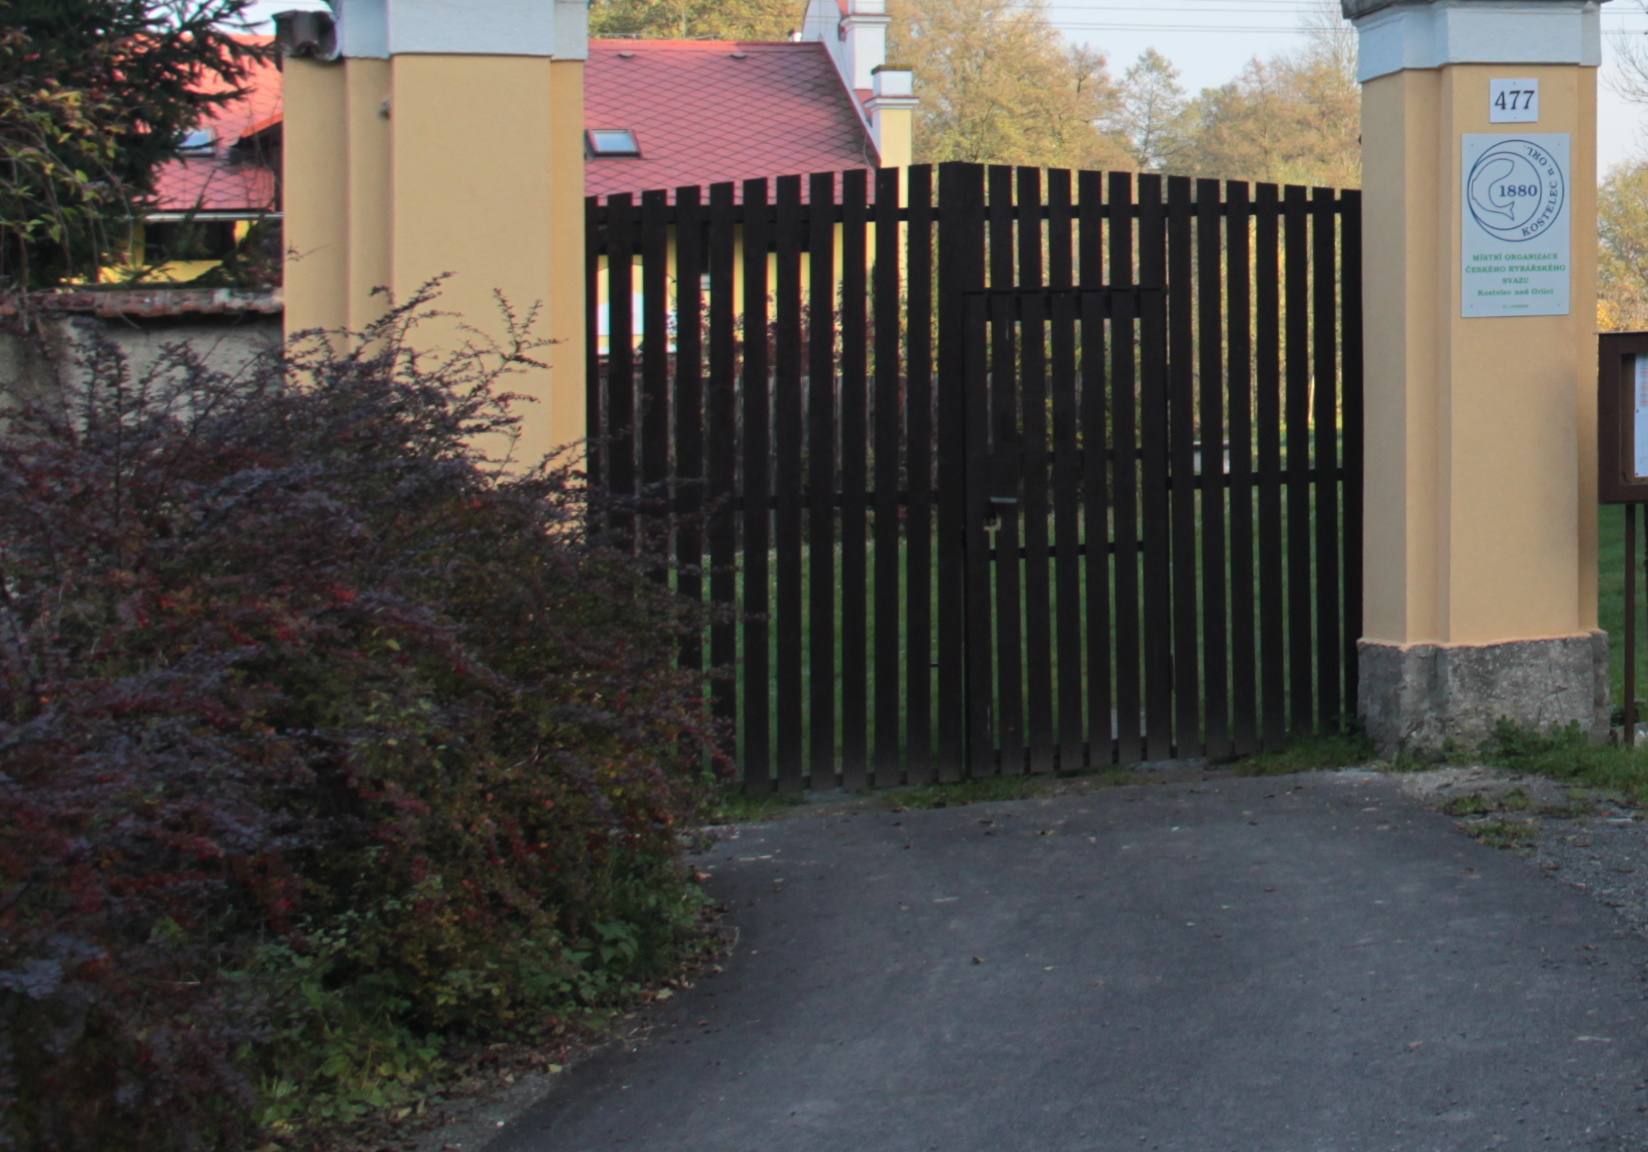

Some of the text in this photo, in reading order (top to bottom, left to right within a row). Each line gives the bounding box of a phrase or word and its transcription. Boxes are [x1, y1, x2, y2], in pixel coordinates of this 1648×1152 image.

[1494, 90, 1535, 110] 477
[1500, 184, 1538, 197] 1880
[1521, 180, 1558, 237] KOSTELEC
[1505, 252, 1558, 261] ORGANIZACE
[1465, 265, 1506, 273] ČESKÉHO
